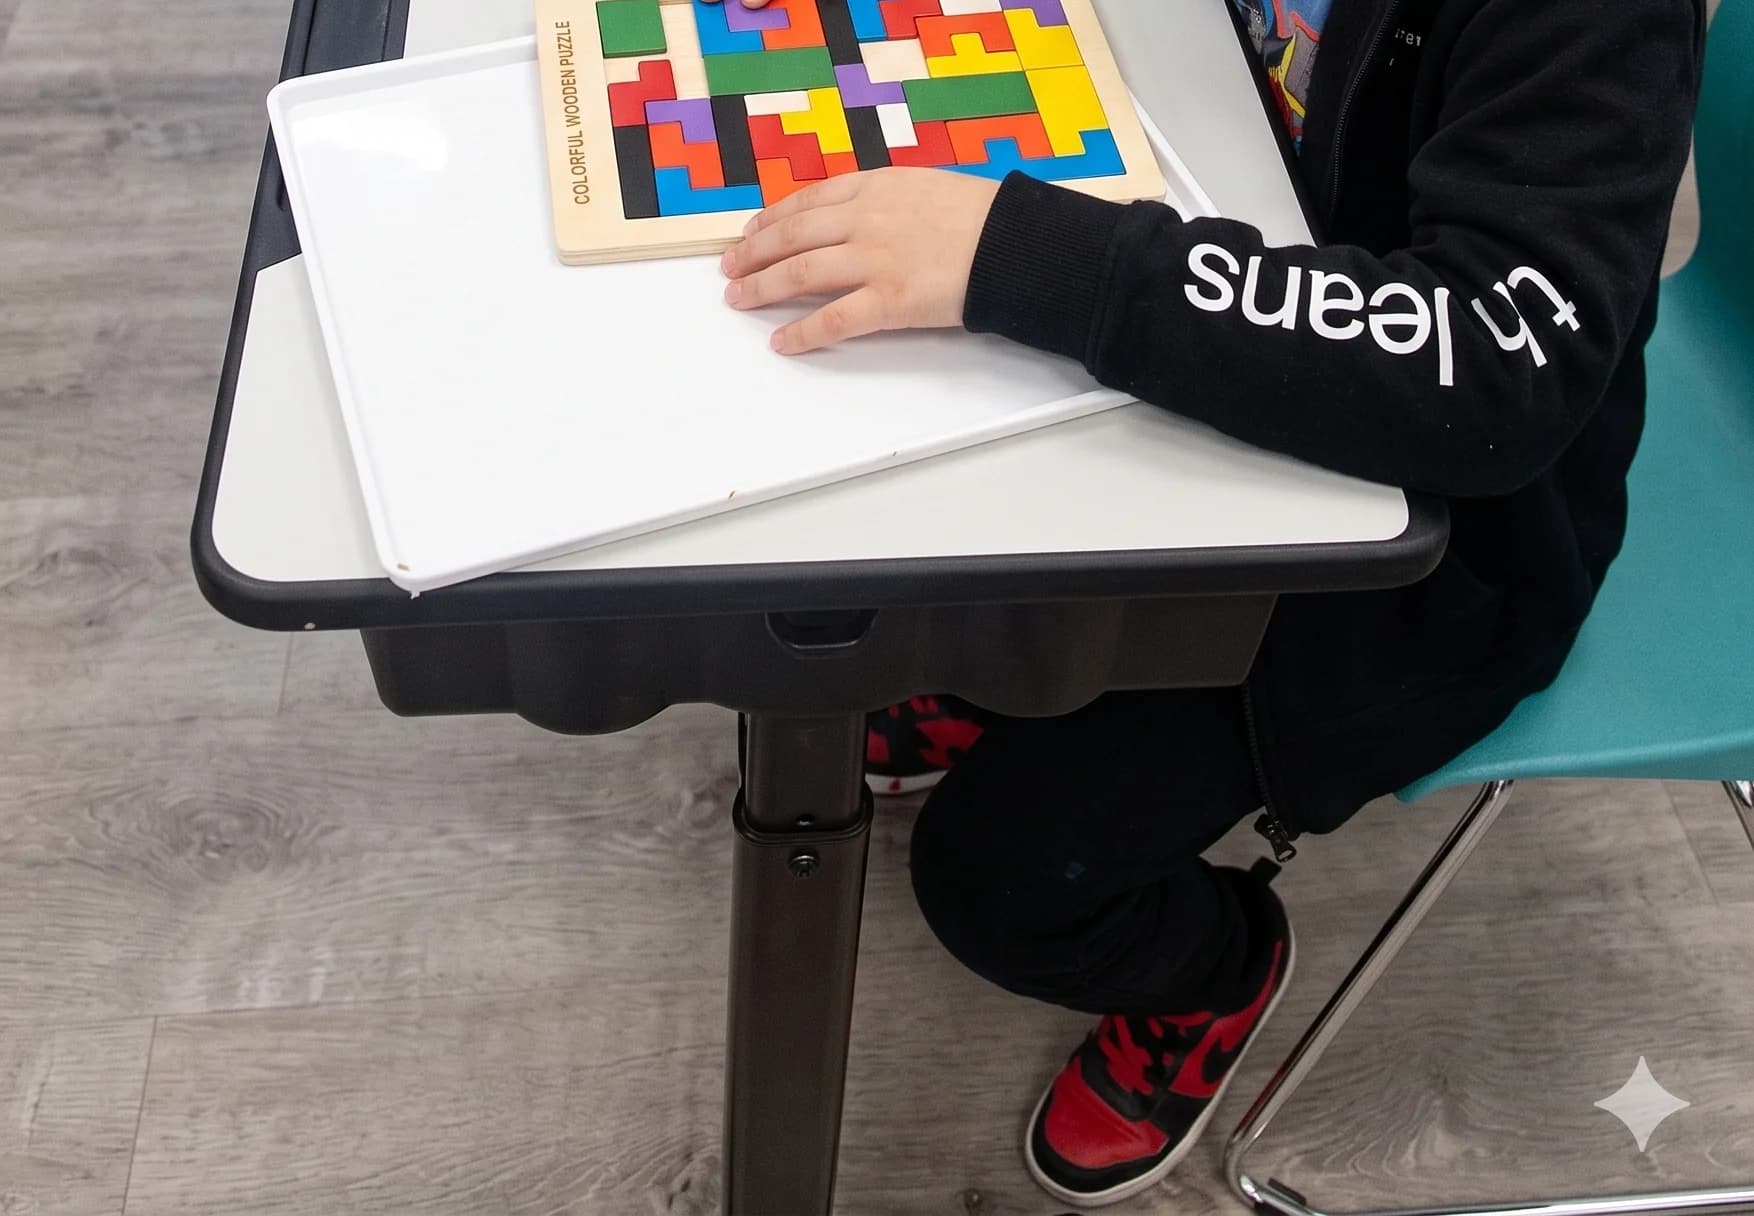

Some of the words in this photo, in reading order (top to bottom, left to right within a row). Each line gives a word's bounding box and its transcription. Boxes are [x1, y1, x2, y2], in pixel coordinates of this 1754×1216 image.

[555, 20, 574, 67] PUZZLE
[561, 69, 581, 127] WOODEN
[568, 130, 590, 205] COLORFUL
